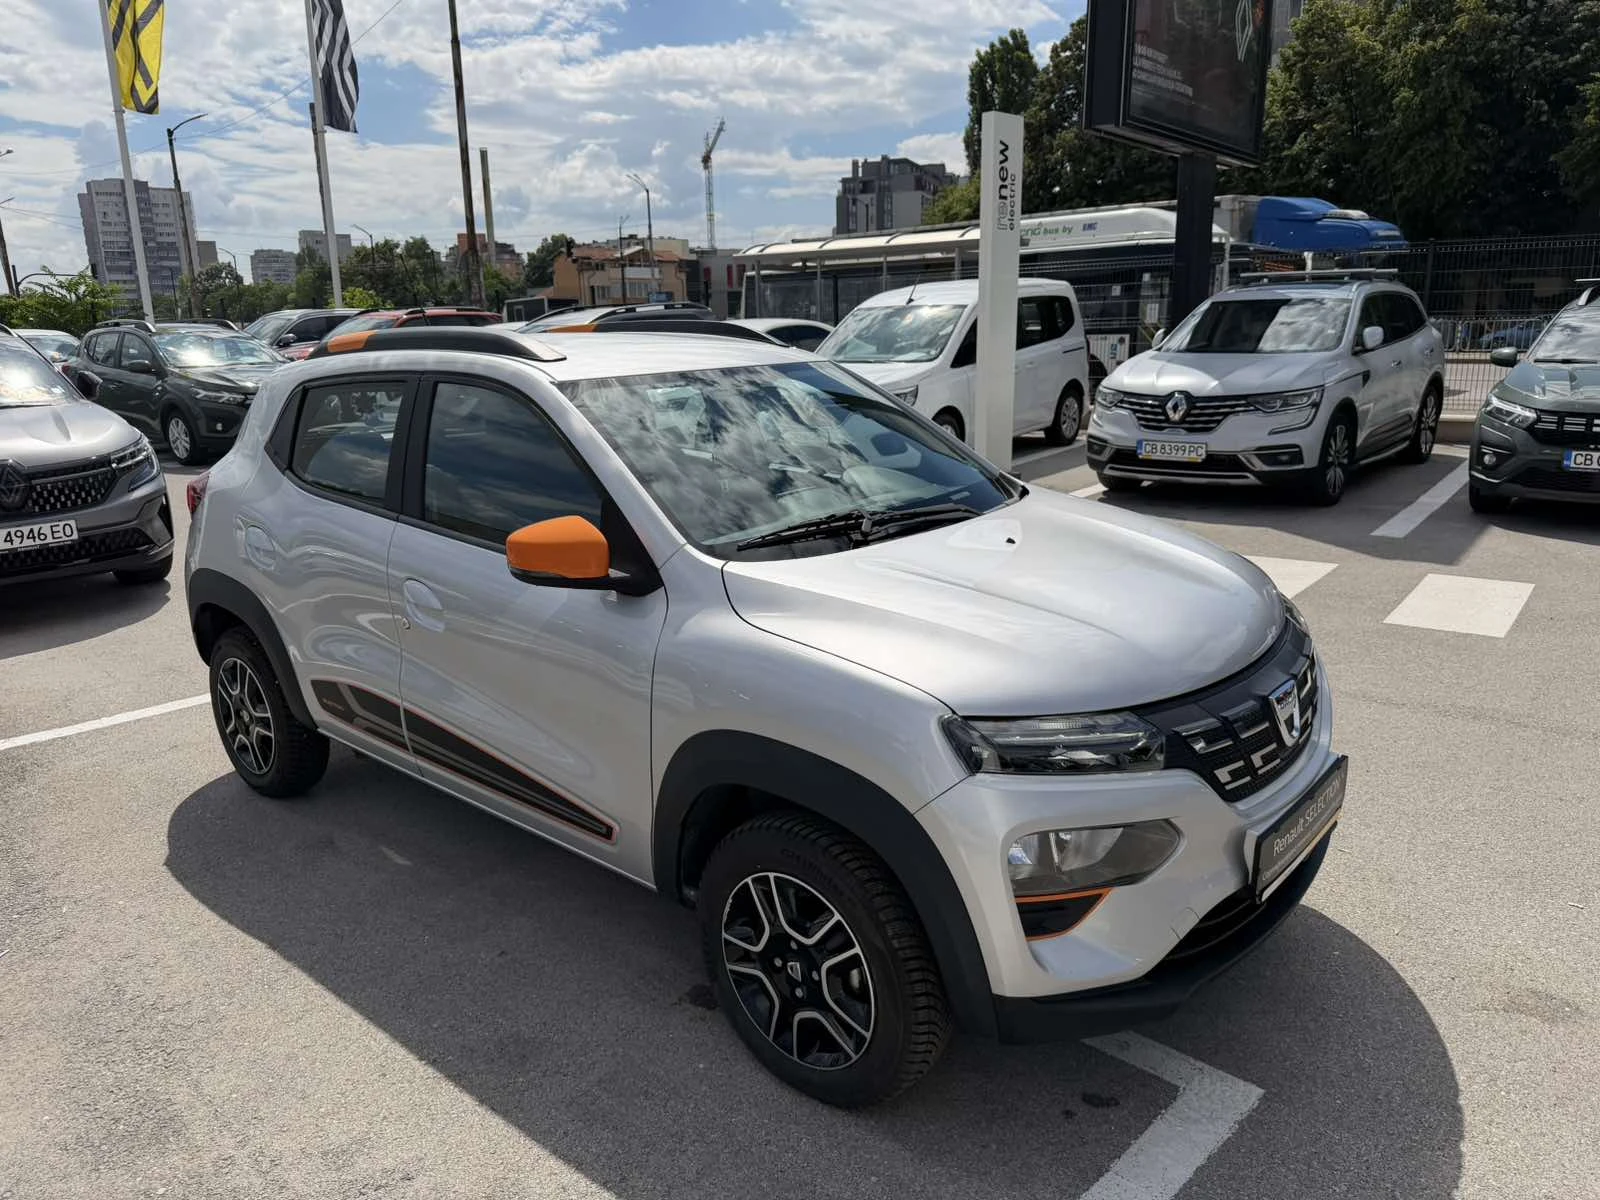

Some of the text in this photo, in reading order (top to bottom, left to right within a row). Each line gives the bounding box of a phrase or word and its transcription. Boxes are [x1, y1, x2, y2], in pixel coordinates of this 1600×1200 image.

[1008, 174, 1016, 231] electric
[1144, 443, 1204, 457] CB 8399 PC
[1574, 453, 1593, 466] CB
[4, 526, 48, 546] 4946
[1273, 816, 1304, 857] Renault
